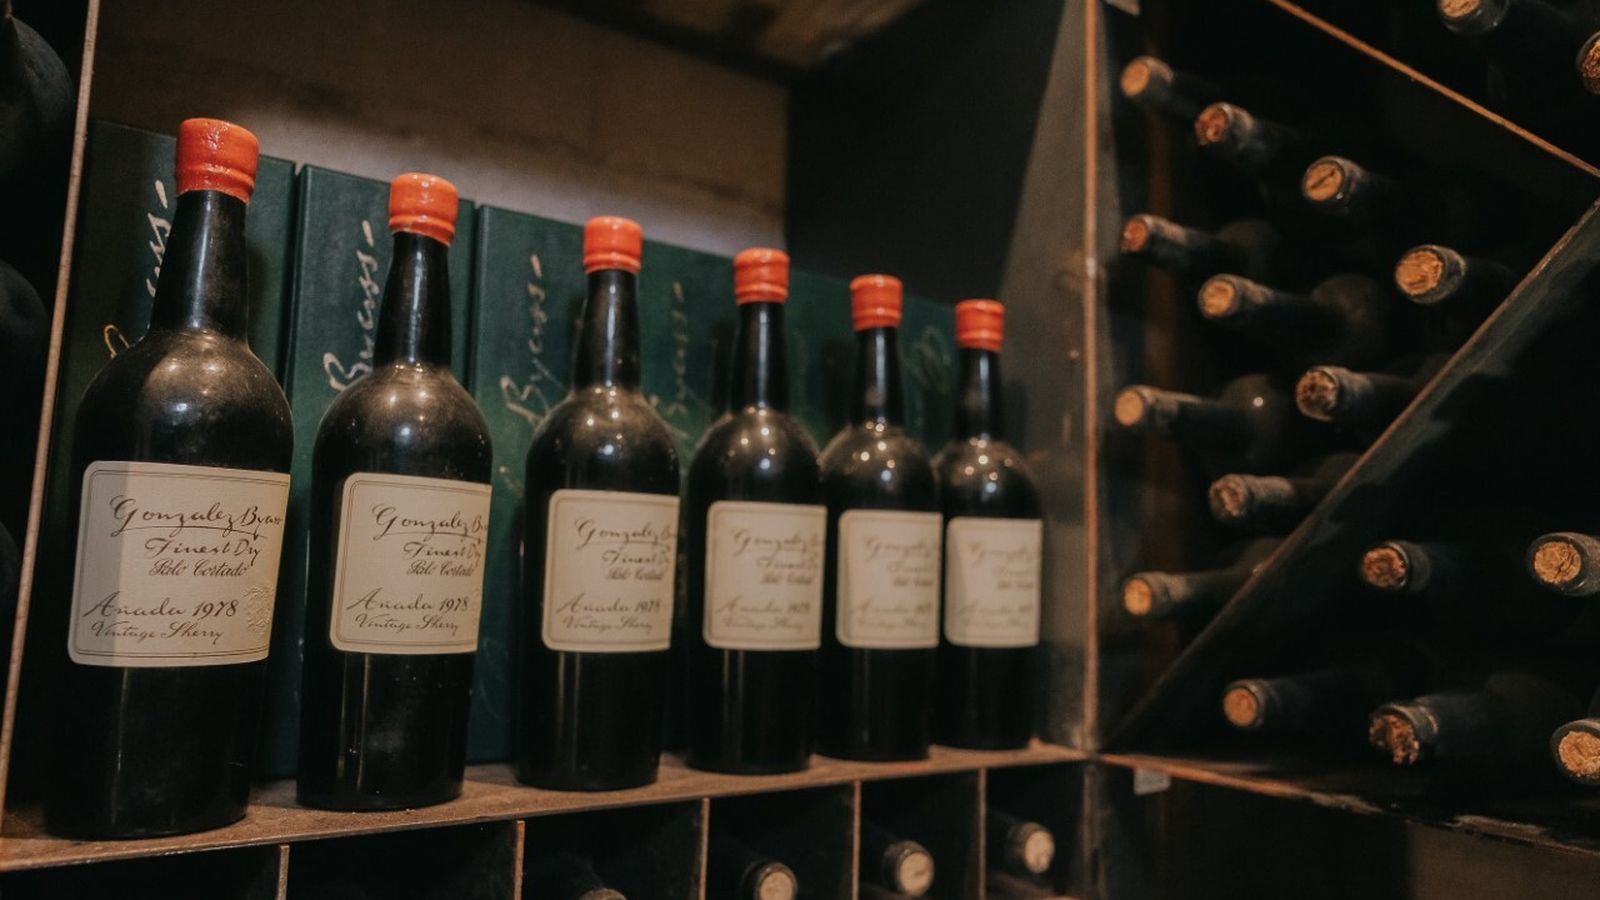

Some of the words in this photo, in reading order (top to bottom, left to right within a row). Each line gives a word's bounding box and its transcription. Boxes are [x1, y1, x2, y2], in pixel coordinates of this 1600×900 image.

[145, 537, 231, 559] Finest
[233, 538, 261, 566] Dry
[403, 541, 465, 560] Finest
[149, 558, 187, 577] Palo
[193, 559, 250, 577] Cortado
[190, 599, 240, 620] 1978
[438, 596, 468, 613] 1978
[91, 621, 156, 643] Vintage
[160, 621, 223, 645] Sherry
[355, 613, 411, 633] Vintage
[415, 614, 459, 636] Sherry
